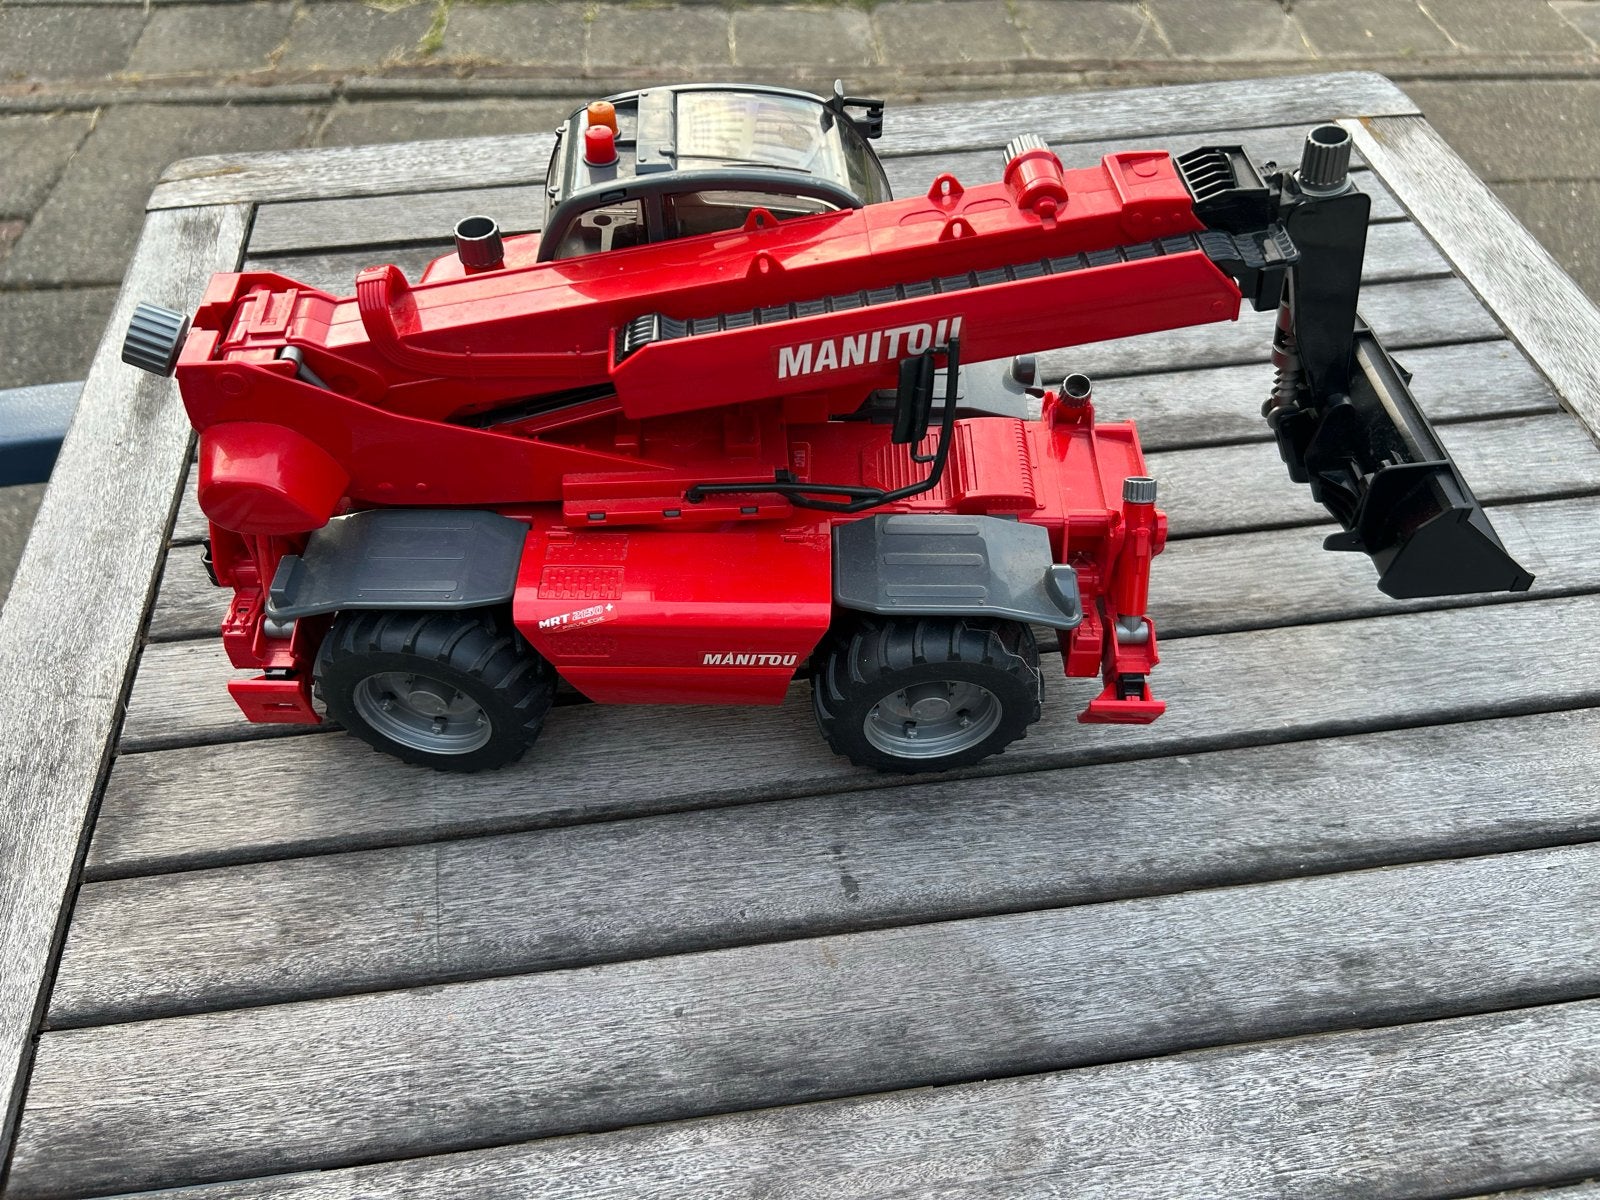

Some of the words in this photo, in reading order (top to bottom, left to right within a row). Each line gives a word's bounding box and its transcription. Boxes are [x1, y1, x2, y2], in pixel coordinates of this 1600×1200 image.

[778, 316, 962, 379] MANITOU
[538, 613, 570, 629] MRT
[703, 652, 797, 666] MANITOU
